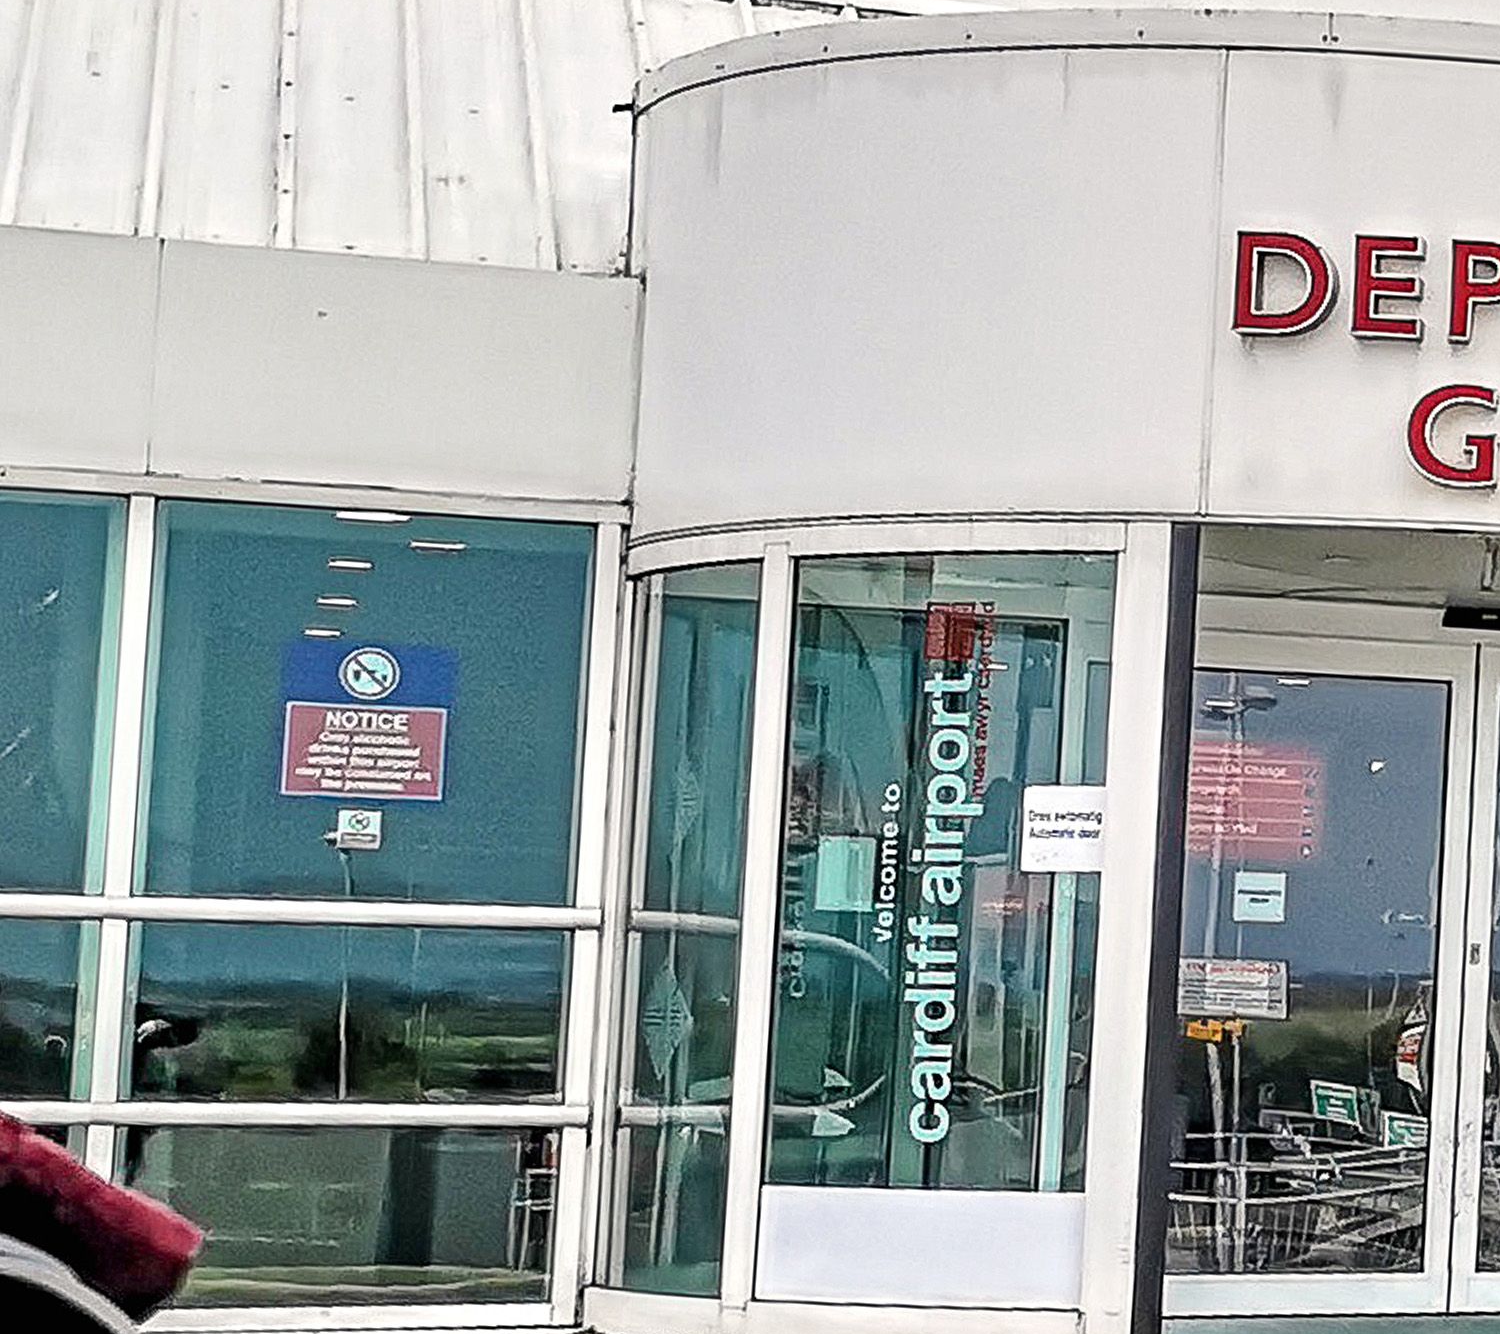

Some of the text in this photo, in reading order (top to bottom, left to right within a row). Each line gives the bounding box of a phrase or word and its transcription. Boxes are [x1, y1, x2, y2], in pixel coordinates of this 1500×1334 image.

[325, 710, 410, 732] NOTICE
[880, 782, 901, 813] to
[903, 670, 986, 1145] cardiff airport
